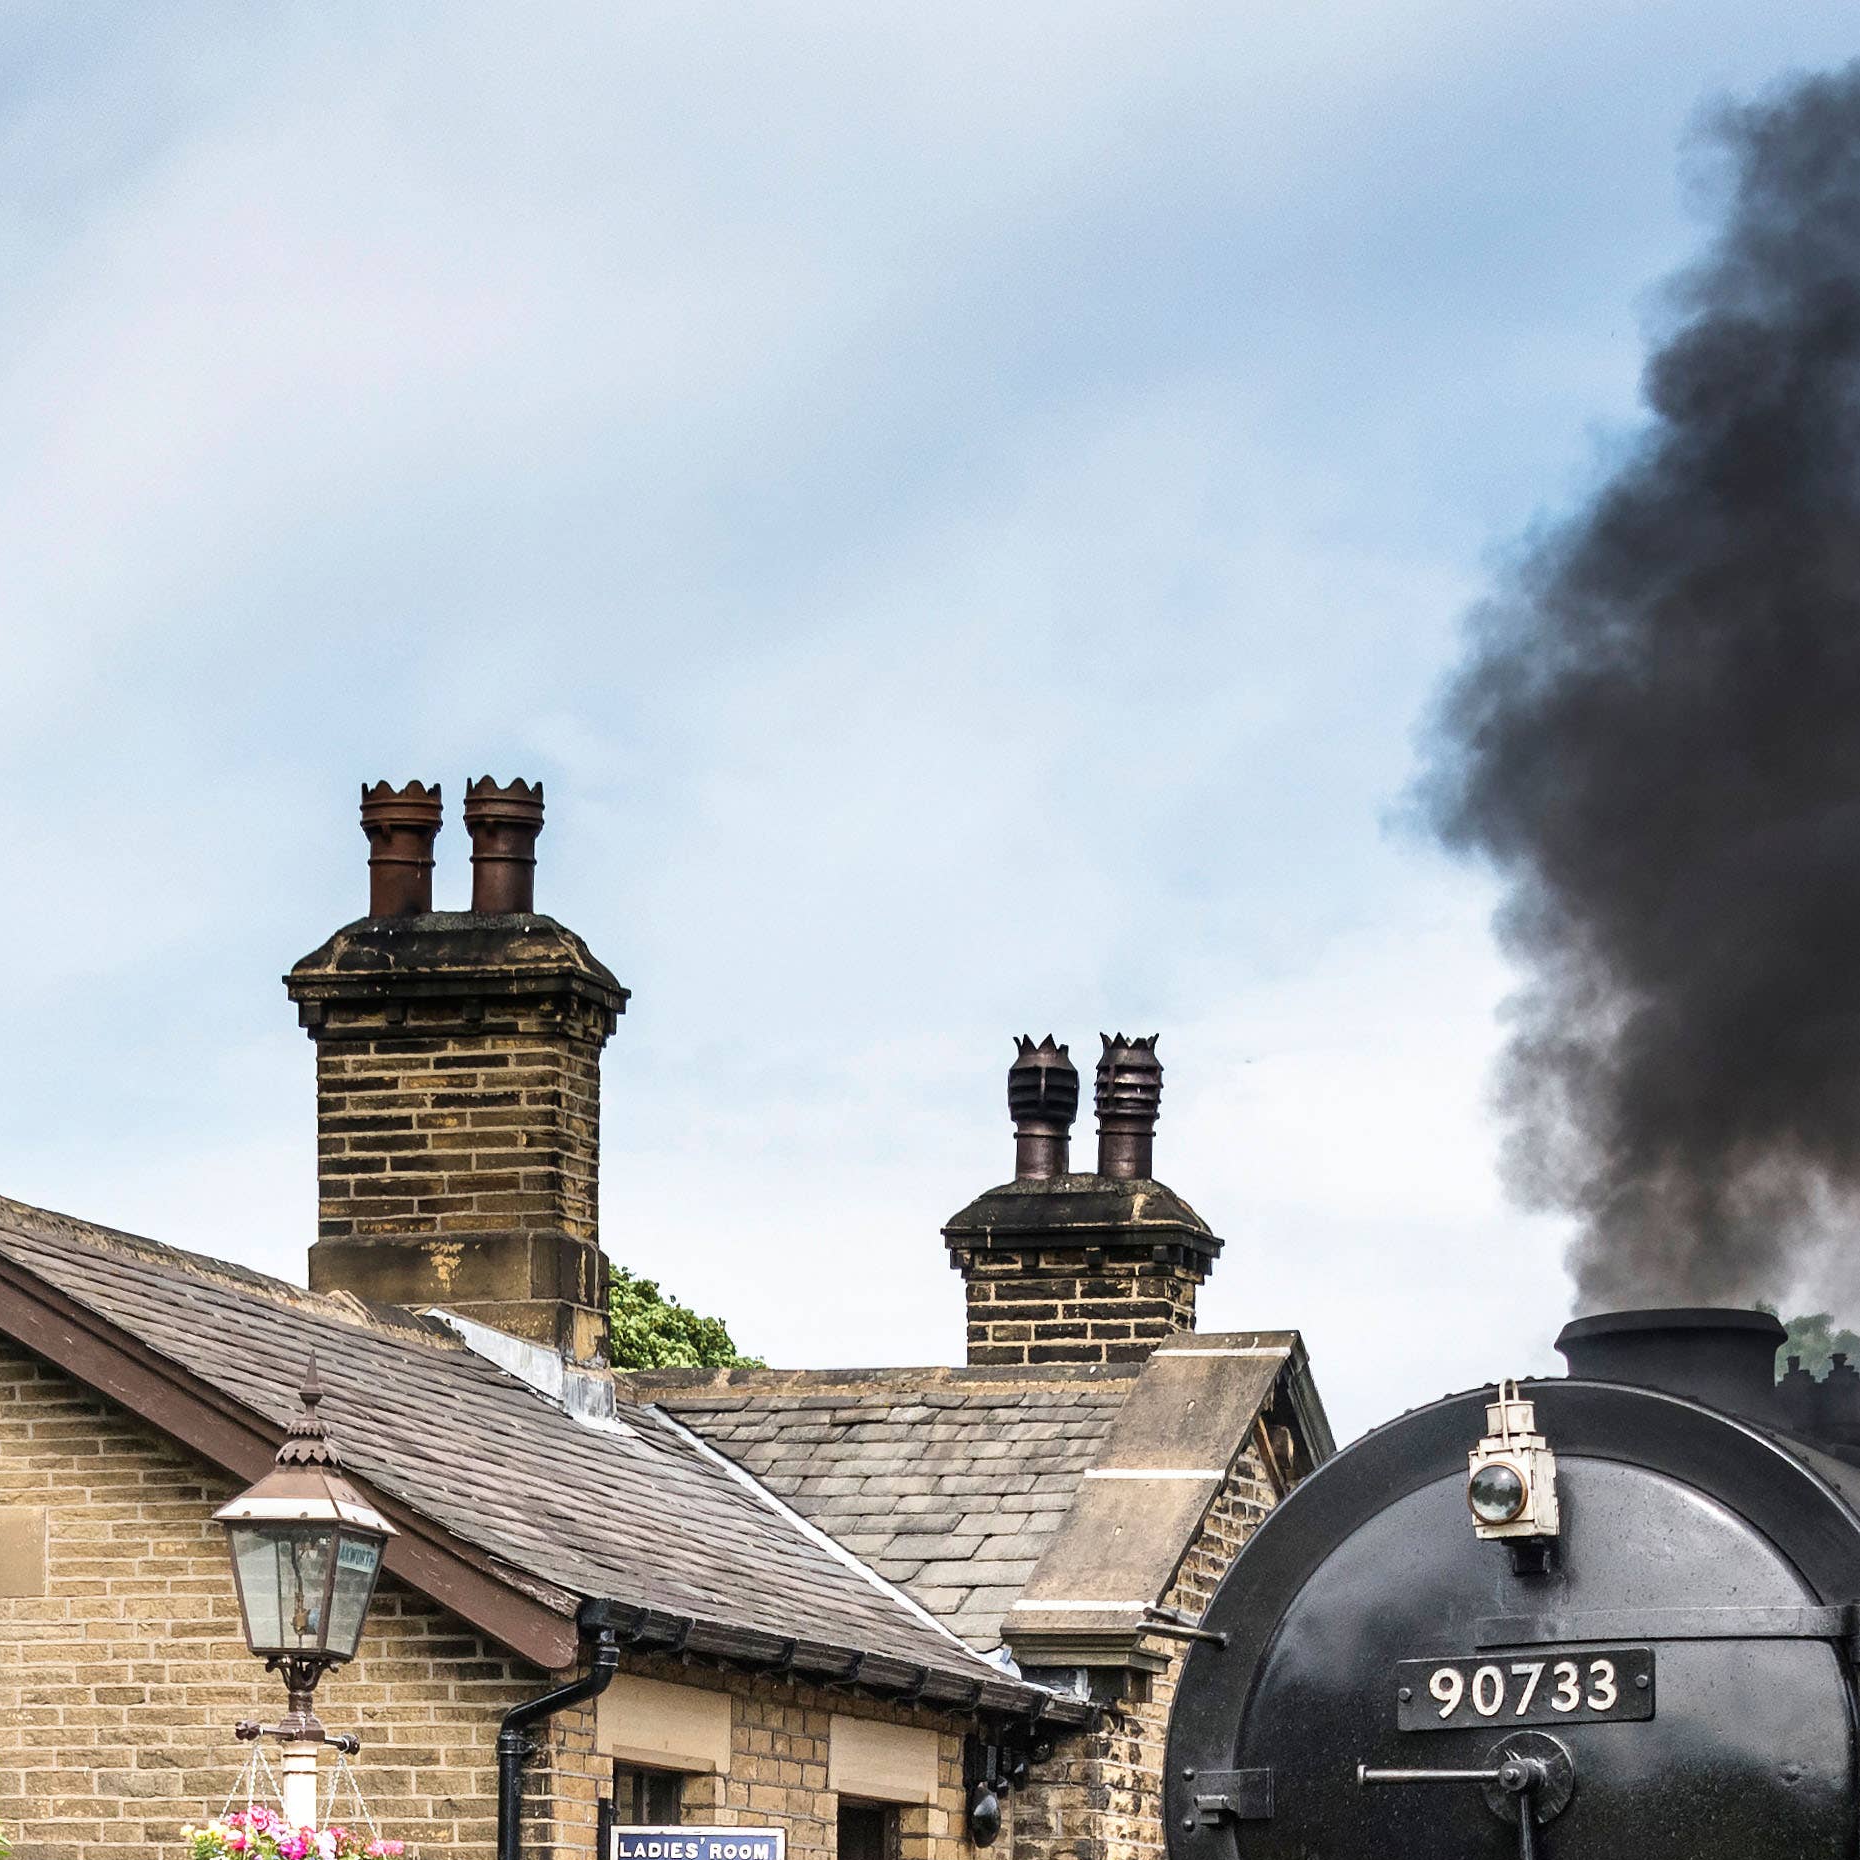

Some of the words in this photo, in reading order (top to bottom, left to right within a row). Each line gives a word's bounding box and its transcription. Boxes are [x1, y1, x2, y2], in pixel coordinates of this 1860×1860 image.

[1429, 1659, 1619, 1719] 90733
[619, 1837, 705, 1859] LADIES'
[709, 1843, 770, 1860] ROOM
